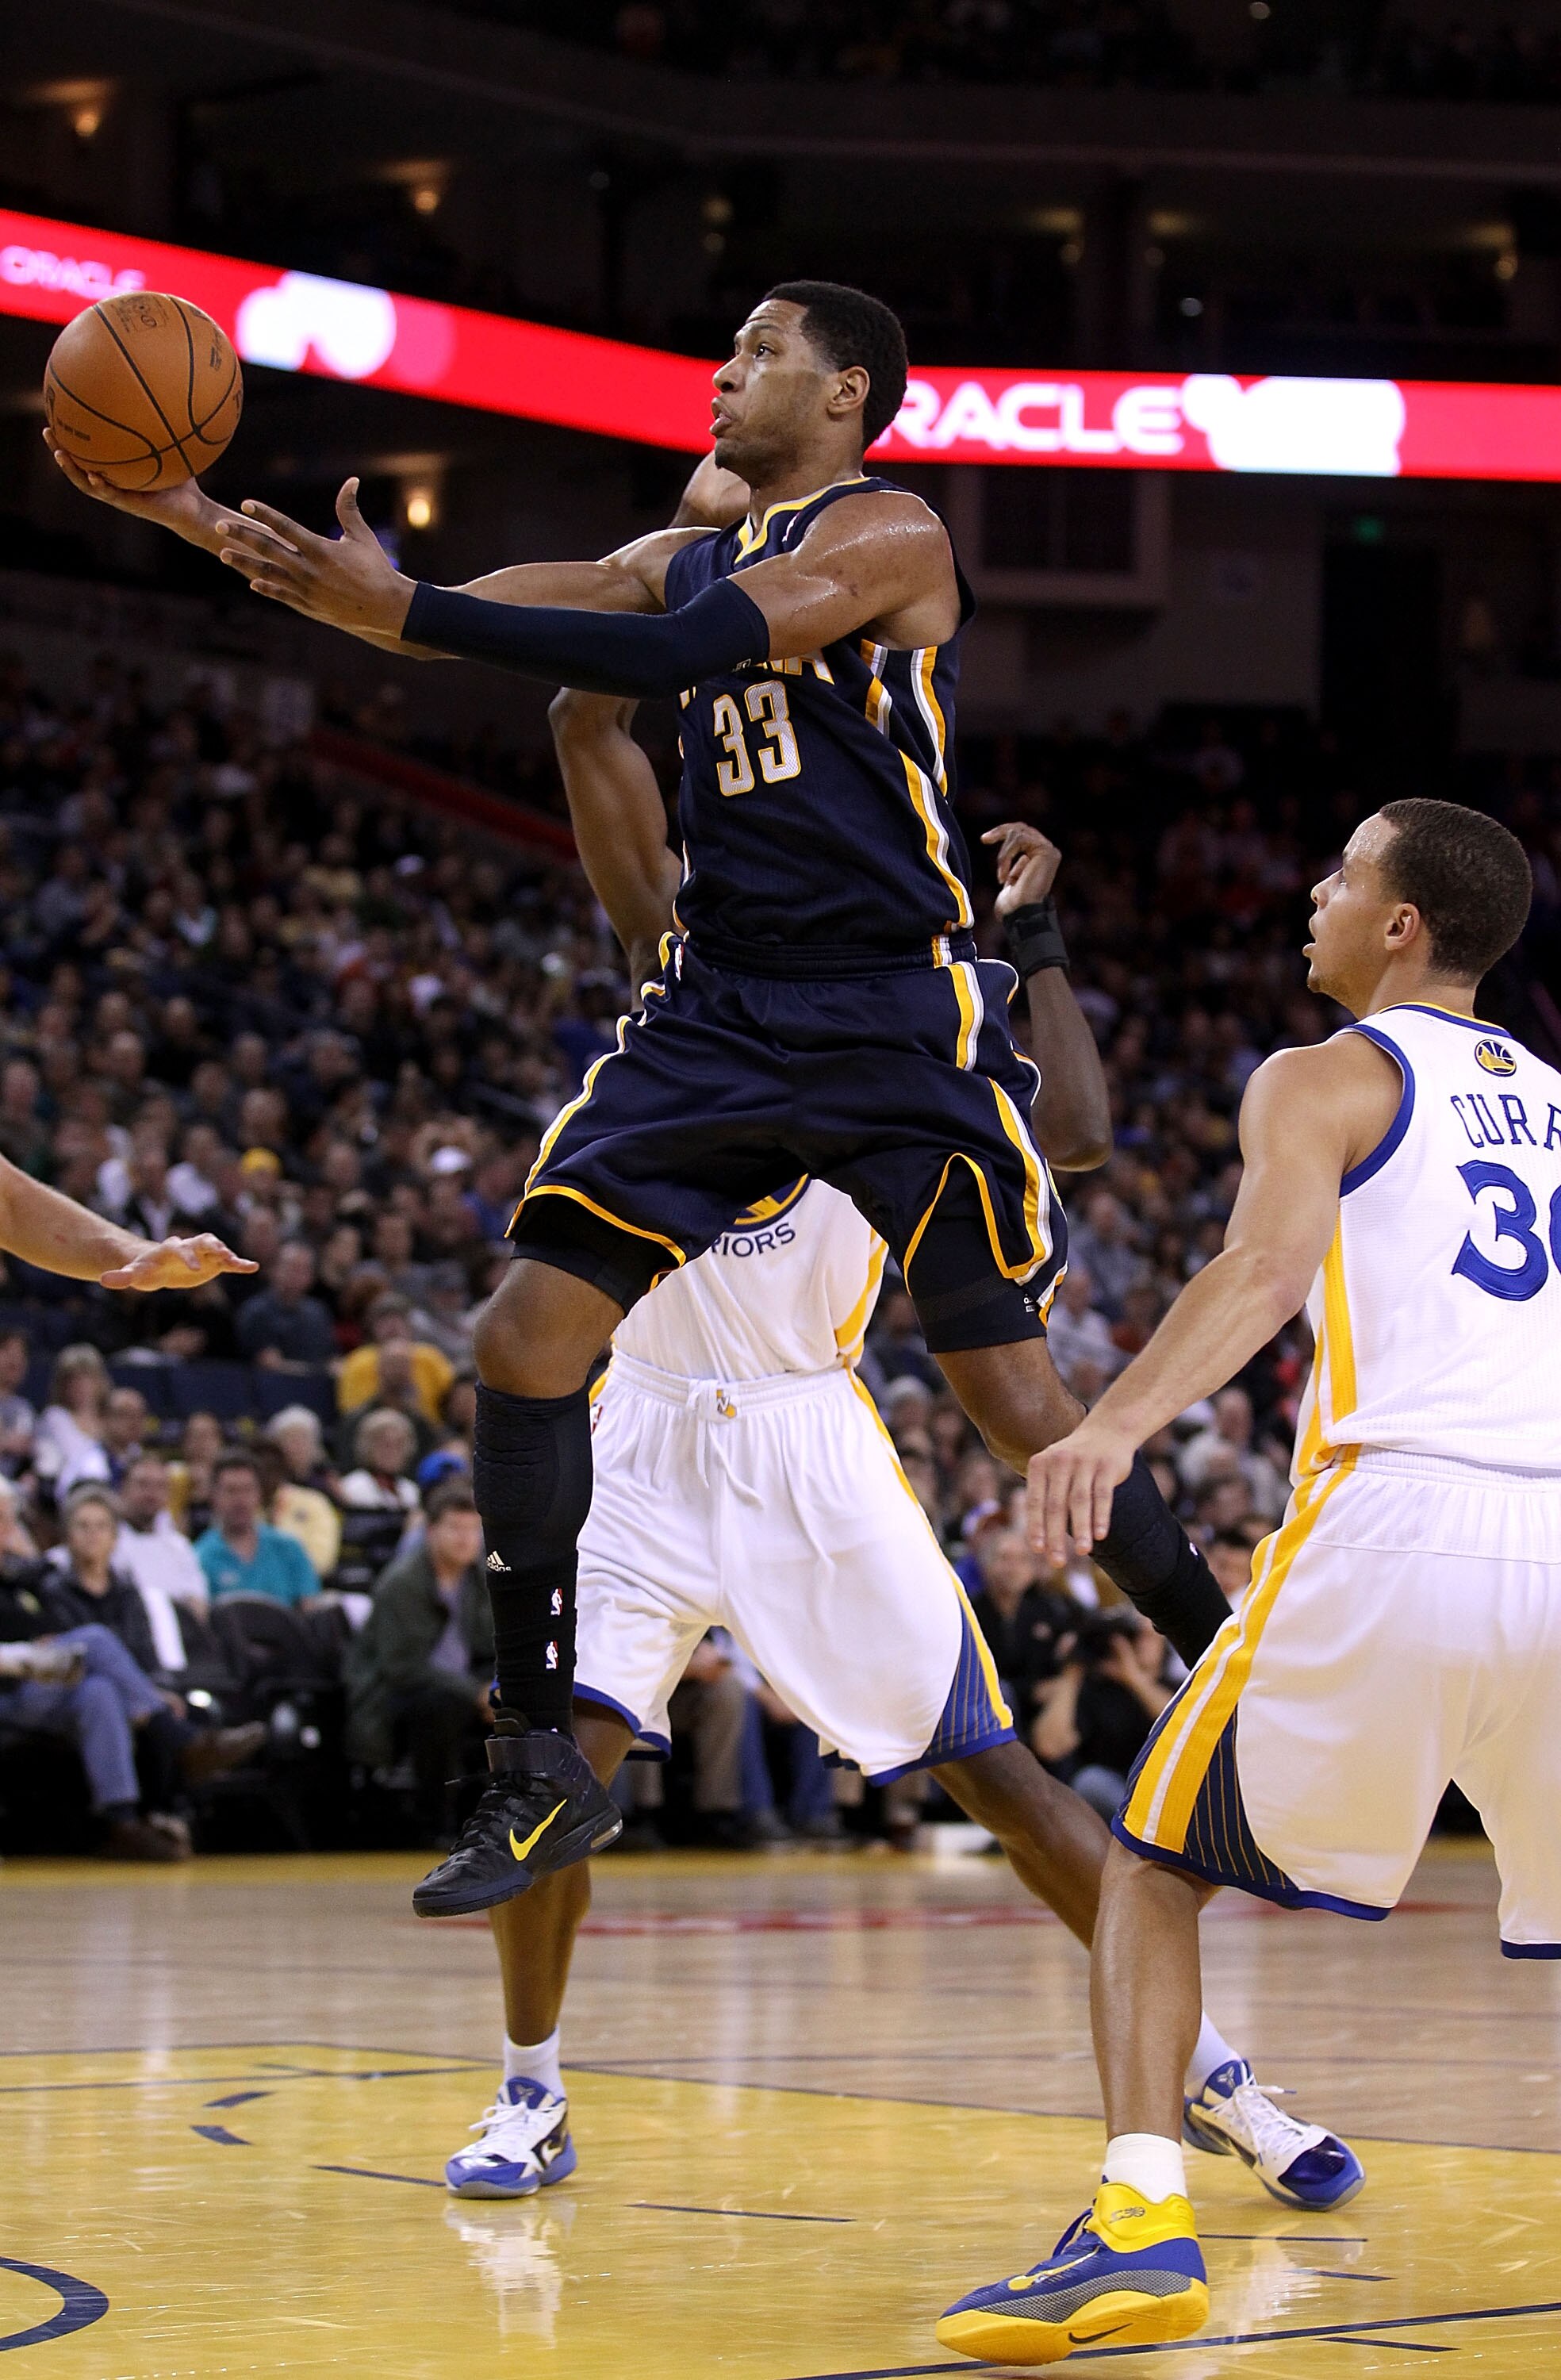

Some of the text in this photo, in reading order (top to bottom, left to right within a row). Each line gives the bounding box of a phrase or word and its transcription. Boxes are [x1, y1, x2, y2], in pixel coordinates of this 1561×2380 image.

[873, 381, 1185, 455] RACLE
[713, 679, 801, 797] 33
[1452, 1159, 1561, 1302] 3
